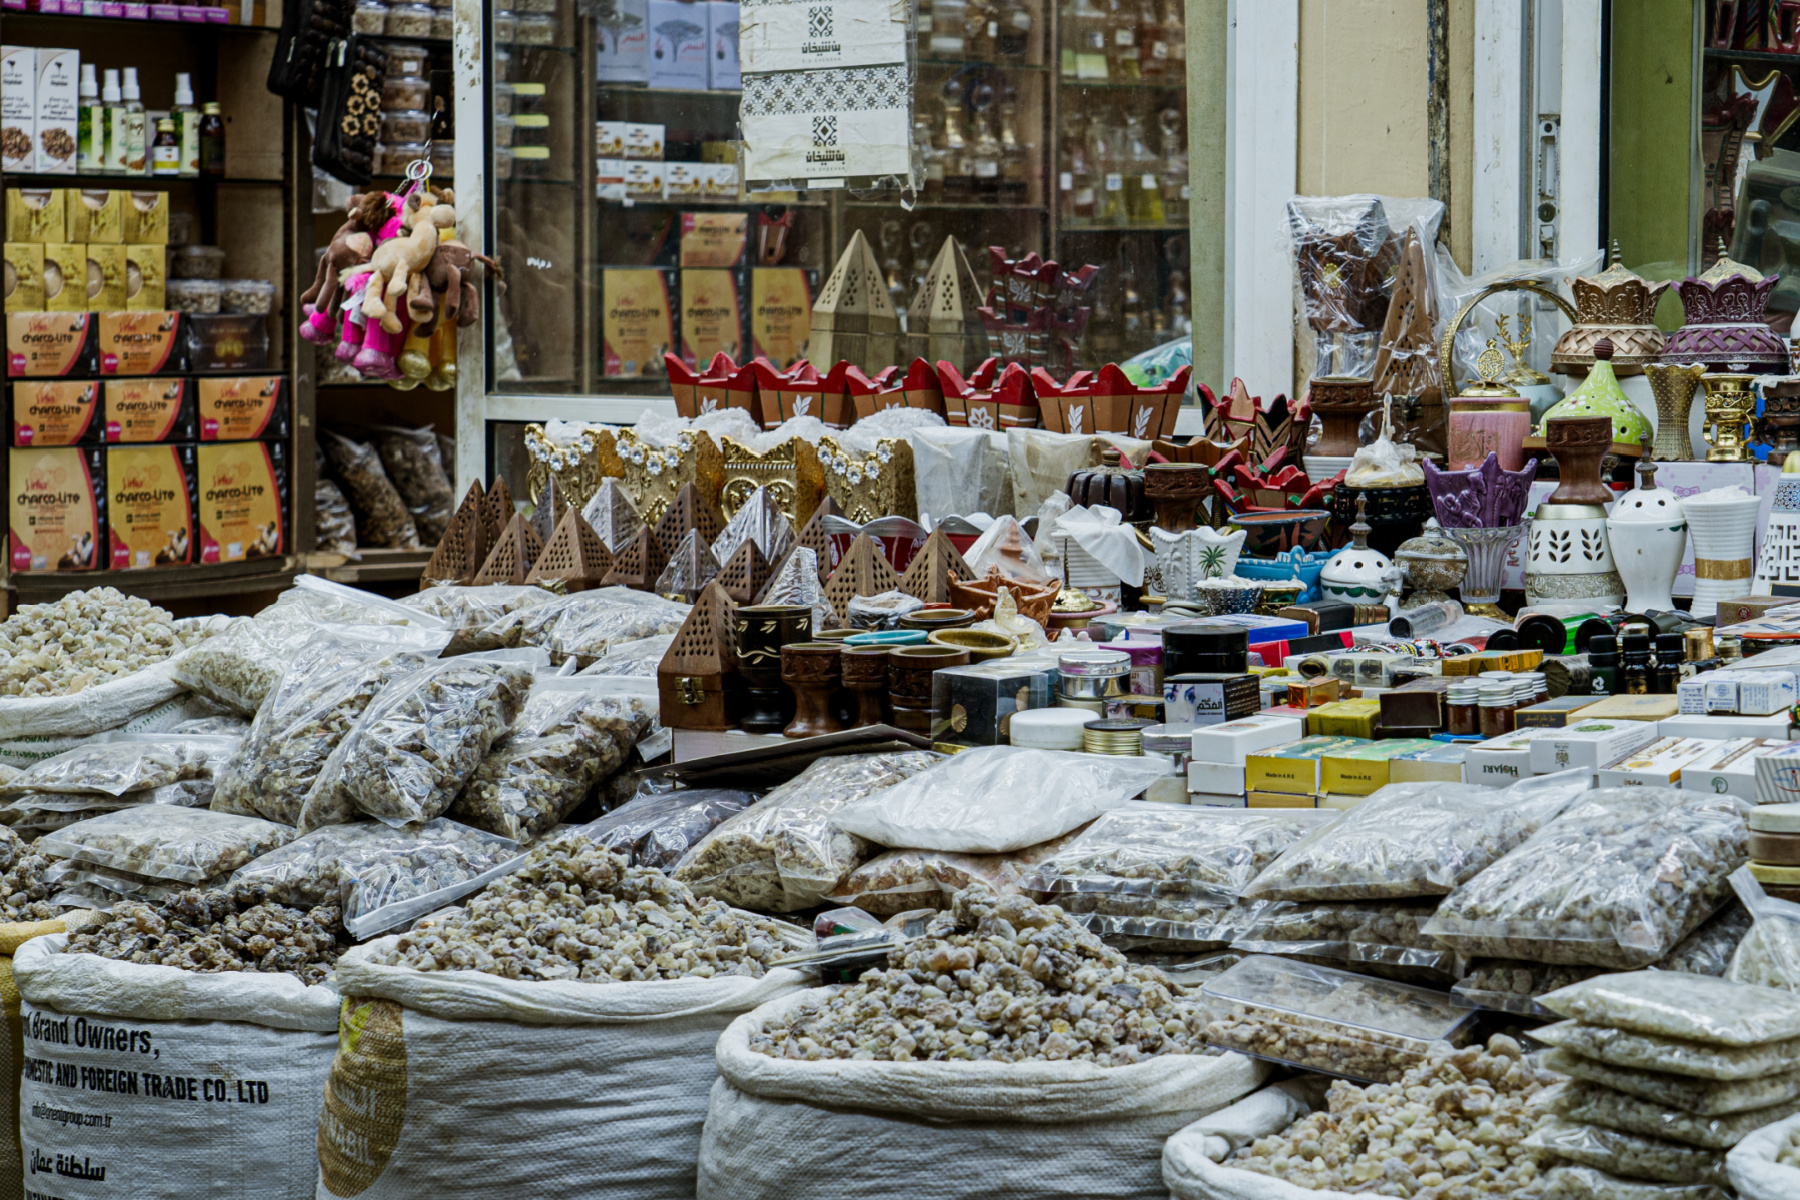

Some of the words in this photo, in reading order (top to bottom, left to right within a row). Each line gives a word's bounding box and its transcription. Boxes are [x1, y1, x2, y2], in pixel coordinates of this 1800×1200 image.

[33, 1012, 69, 1044] Brand
[74, 1017, 160, 1060] Owners,
[55, 1063, 78, 1088] AND
[80, 1066, 138, 1095] FOREIGN
[142, 1073, 198, 1101] TRADE
[202, 1077, 231, 1103] CO.
[237, 1079, 270, 1104] LTD
[30, 1148, 52, 1175] عمان
[56, 1154, 106, 1181] سلطنة
